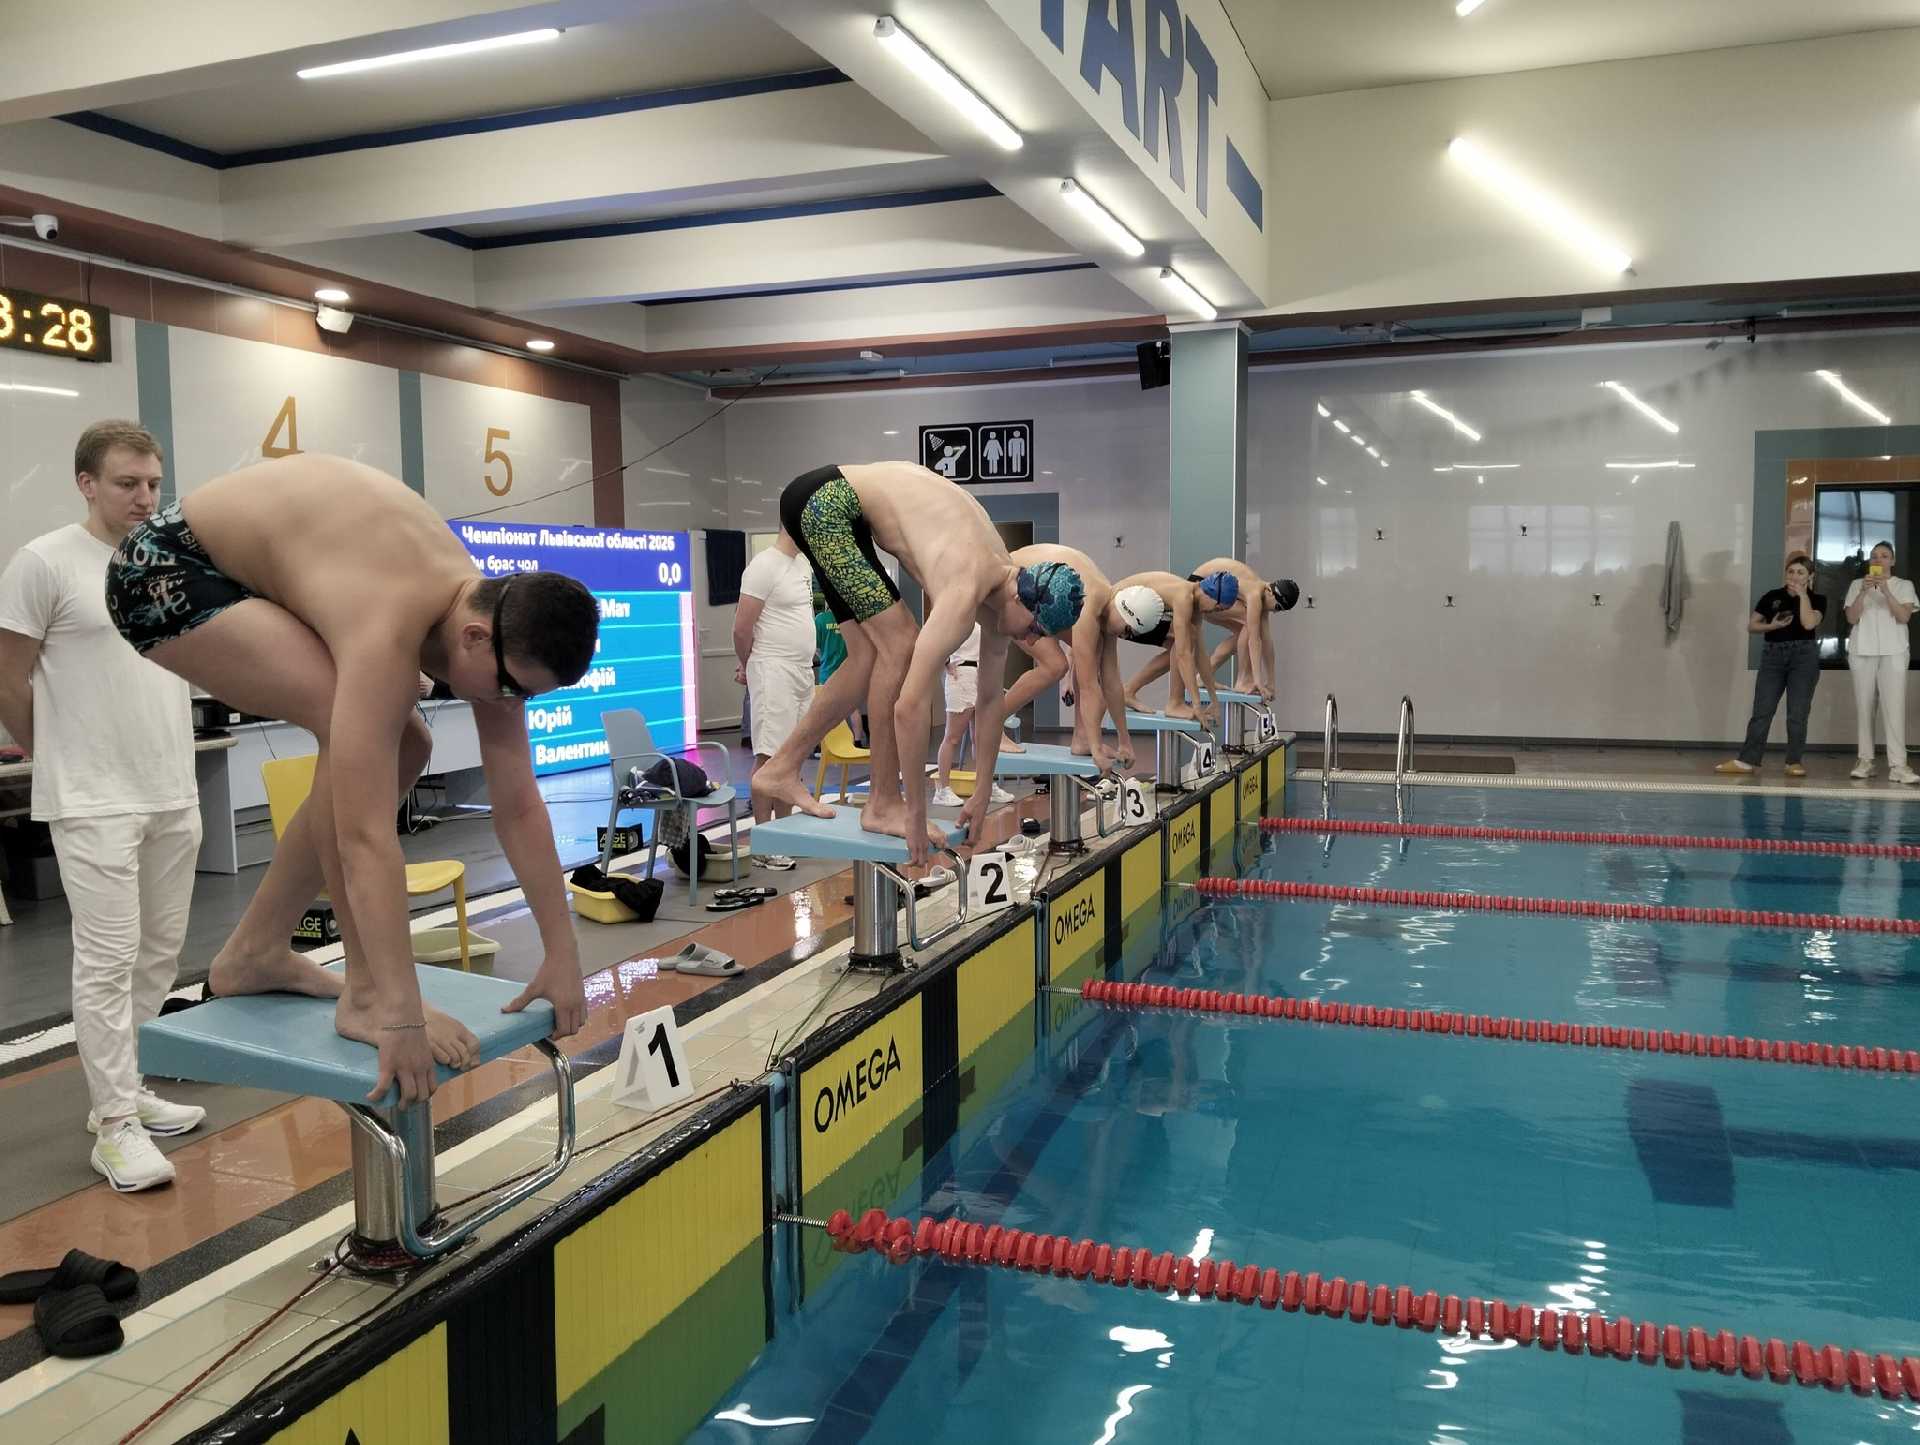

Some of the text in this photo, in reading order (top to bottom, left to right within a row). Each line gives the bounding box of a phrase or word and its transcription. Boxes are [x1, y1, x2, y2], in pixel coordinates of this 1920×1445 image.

[262, 396, 304, 458] 4
[484, 428, 512, 496] 5
[462, 526, 675, 551] Чемпіонат Львівської області 2026
[487, 555, 515, 575] брас
[517, 559, 538, 572] чол
[658, 562, 682, 586] 0,0
[528, 705, 573, 733] Юрій
[536, 740, 610, 765] Валентин
[1202, 748, 1213, 769] 4
[1126, 788, 1145, 818] 3
[599, 831, 626, 844] AGE
[1171, 821, 1196, 854] OMEGA
[980, 862, 1008, 905] 2
[1054, 893, 1096, 945] OMEGA
[648, 1022, 680, 1088] 1
[814, 1034, 901, 1133] OMEGA
